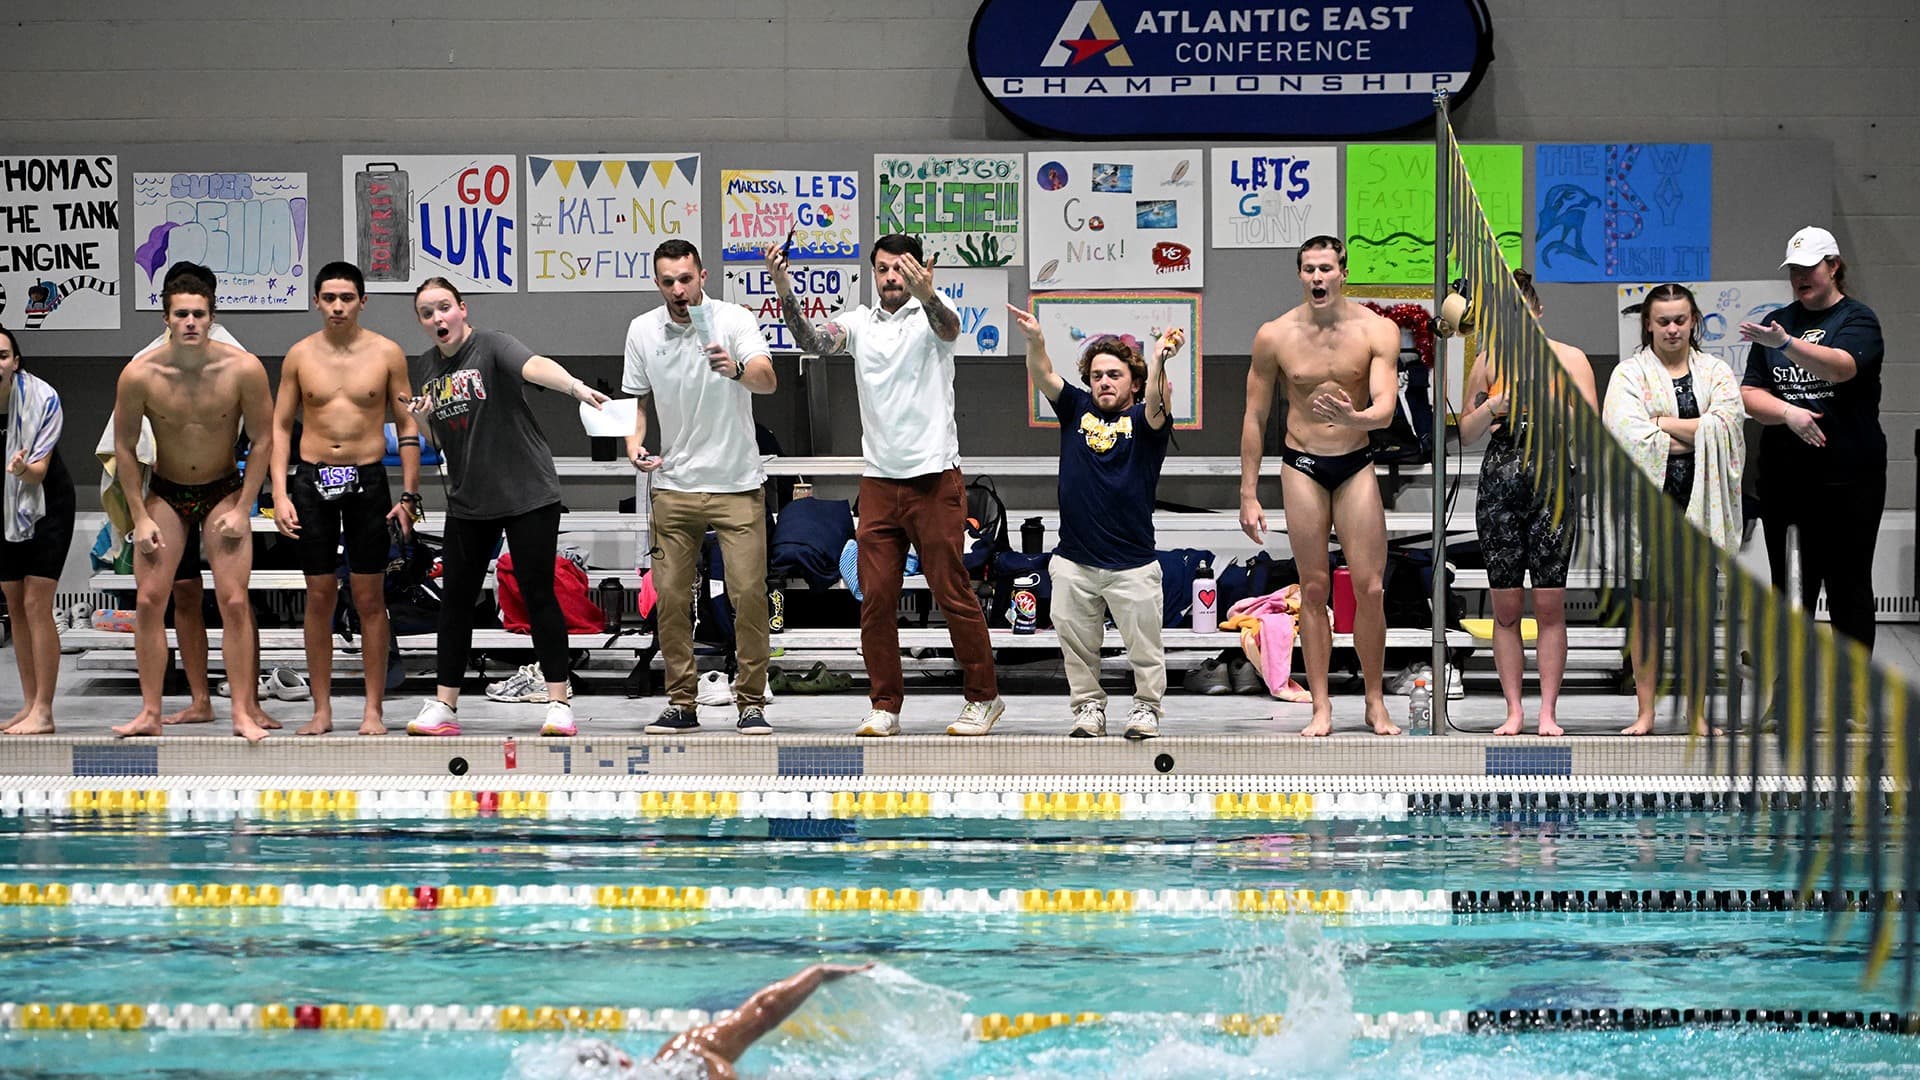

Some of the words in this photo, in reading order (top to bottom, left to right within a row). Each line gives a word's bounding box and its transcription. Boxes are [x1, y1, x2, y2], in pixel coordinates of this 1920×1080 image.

[1133, 8, 1311, 34] ATLANTIC
[1322, 6, 1414, 32] EAST
[1175, 39, 1372, 63] CONFERENCE
[1003, 74, 1453, 94] CHAMPIONSHIP
[0, 157, 113, 192] HOMAS
[888, 159, 915, 180] YO,
[973, 159, 1010, 180] GO
[1367, 147, 1489, 184] SWM
[1539, 144, 1600, 177] THE
[170, 173, 254, 200] SUPER
[457, 164, 511, 206] GO
[726, 178, 788, 196] MARISSA
[795, 175, 857, 200] LETS
[1230, 155, 1311, 202] LET'S
[755, 201, 790, 215] LAST
[879, 181, 1019, 235] KELSIE!!!
[1356, 188, 1417, 211] FAST
[52, 201, 119, 232] TANK
[797, 202, 835, 228] GO
[1229, 204, 1312, 244] TONY
[419, 202, 514, 287] LUKE
[534, 250, 577, 280] IS
[595, 250, 650, 279] FLYI
[1671, 246, 1711, 277] IT
[746, 271, 807, 295] LE'S
[809, 270, 841, 295] GO
